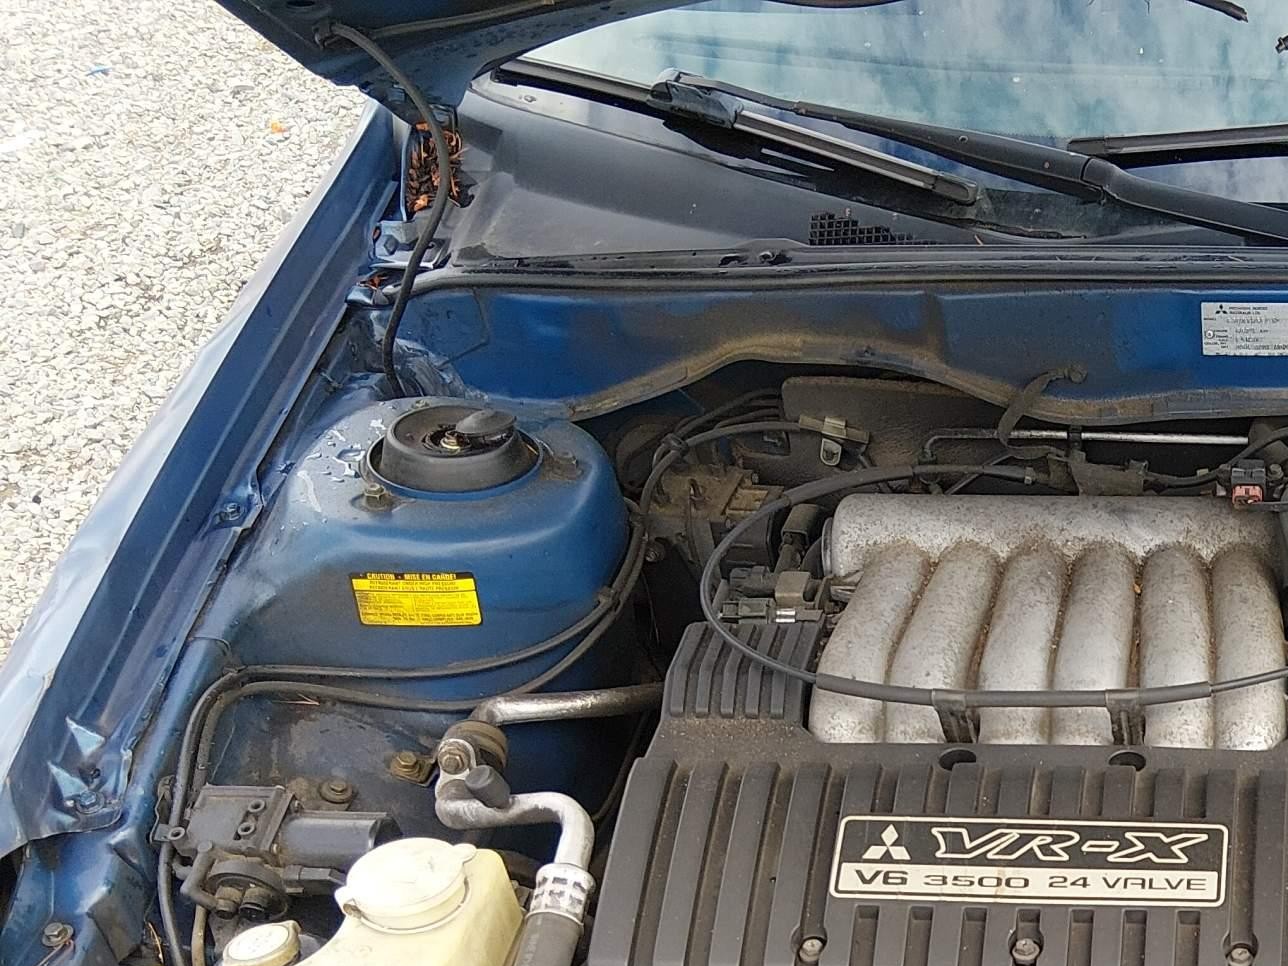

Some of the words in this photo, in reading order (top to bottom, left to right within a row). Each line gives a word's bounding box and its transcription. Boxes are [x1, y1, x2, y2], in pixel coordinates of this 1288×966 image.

[930, 827, 1209, 864] VR-X
[855, 869, 909, 886] V6
[923, 873, 1030, 890] 3500
[1047, 875, 1091, 890] 24
[1102, 877, 1207, 892] VALVE
